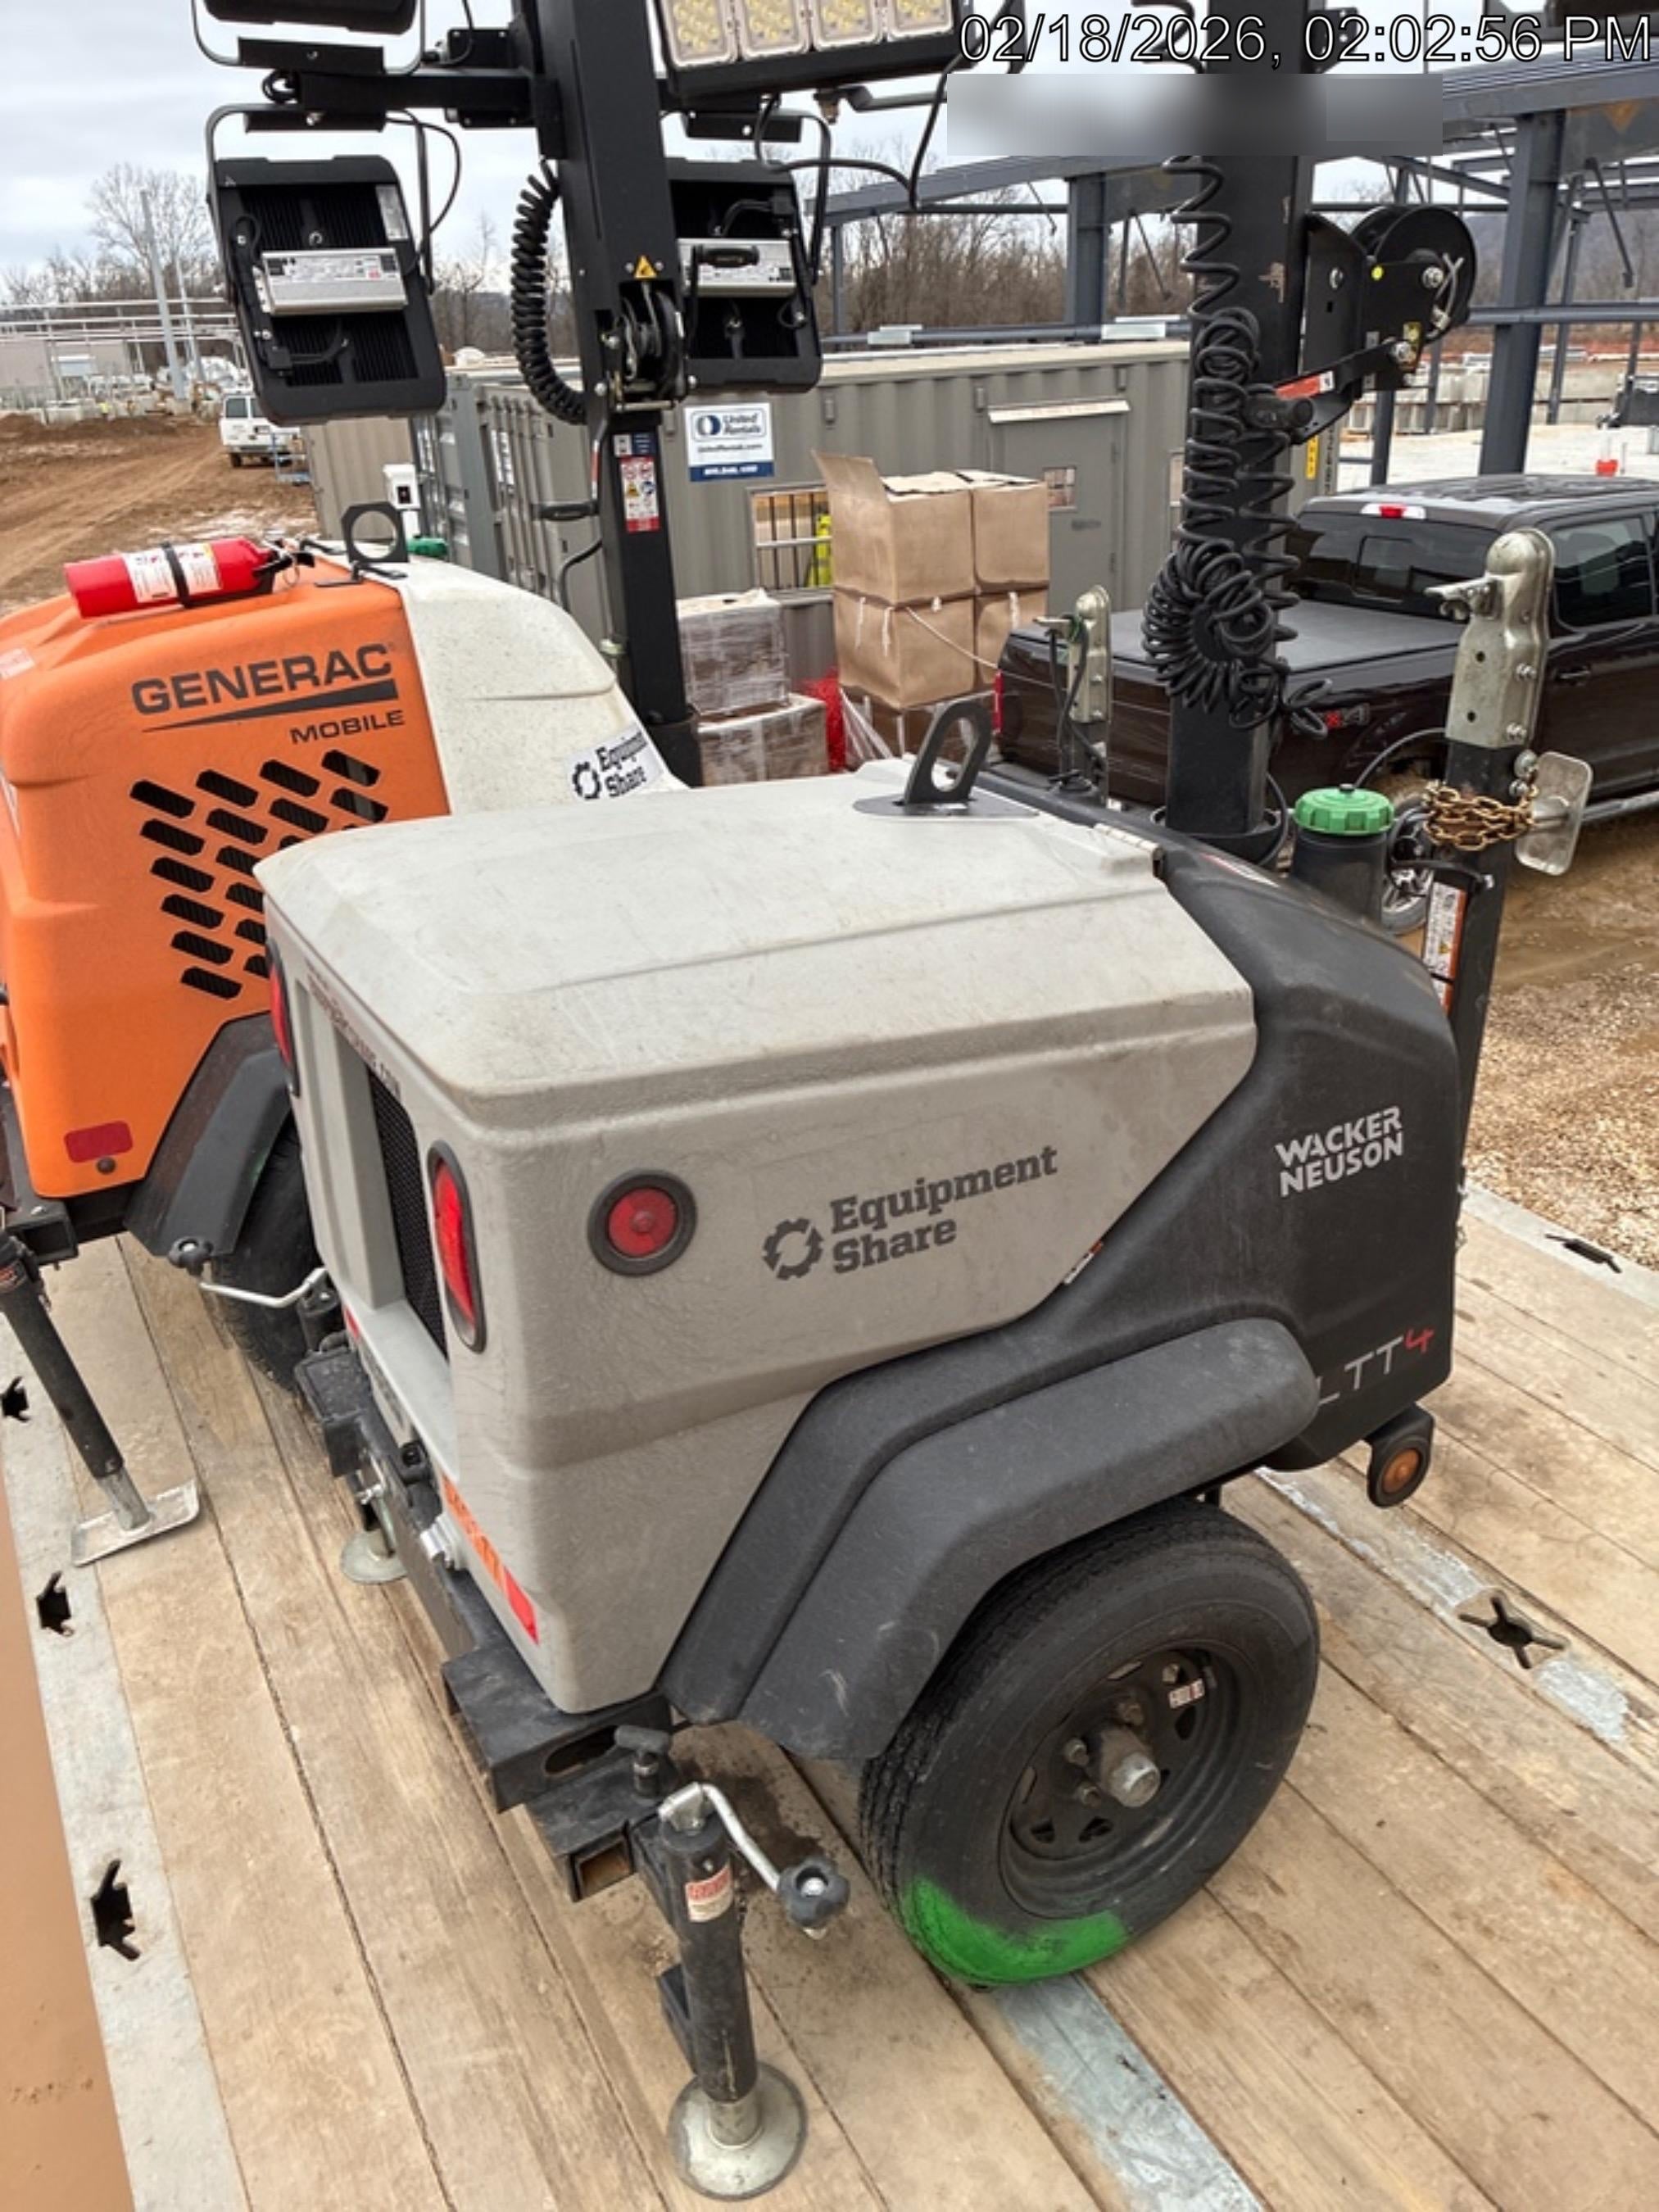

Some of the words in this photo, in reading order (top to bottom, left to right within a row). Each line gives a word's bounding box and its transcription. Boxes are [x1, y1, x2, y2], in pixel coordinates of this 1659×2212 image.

[131, 643, 392, 715] GENERAC
[290, 709, 406, 745] MOBILE
[1275, 1105, 1403, 1167] WACKER
[1279, 1130, 1403, 1197] NEUSON
[829, 1145, 1058, 1235] Equipment
[832, 1218, 957, 1275] Share
